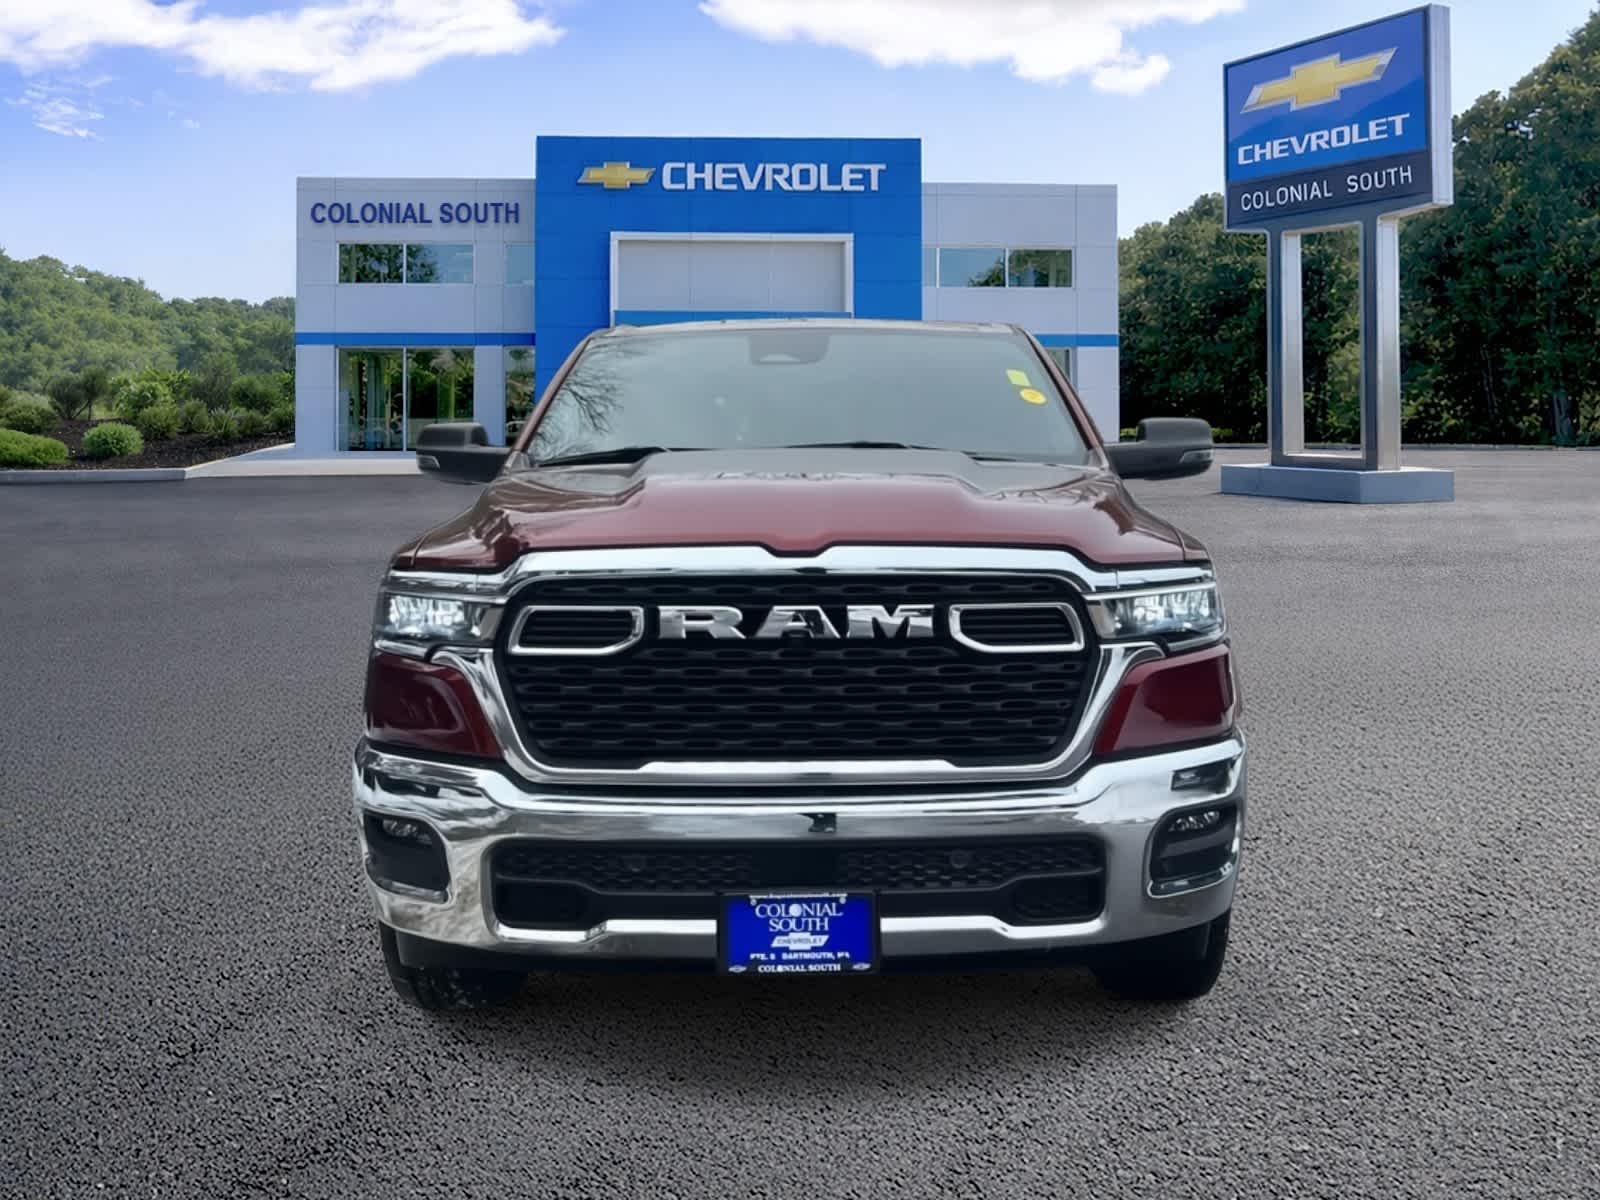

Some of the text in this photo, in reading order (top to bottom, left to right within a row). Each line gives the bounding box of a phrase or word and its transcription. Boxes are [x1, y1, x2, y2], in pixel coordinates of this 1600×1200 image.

[1237, 113, 1411, 166] CHEVROLET
[661, 162, 887, 193] CHEVROLET
[1241, 165, 1413, 212] COLONIAL SOUTH
[310, 201, 521, 226] COLONIAL SOUTH
[657, 604, 935, 639] RAM
[755, 903, 843, 918] COLONIAL
[769, 917, 829, 931] SOUTH
[758, 963, 841, 973] COLONIAL SOUTH
